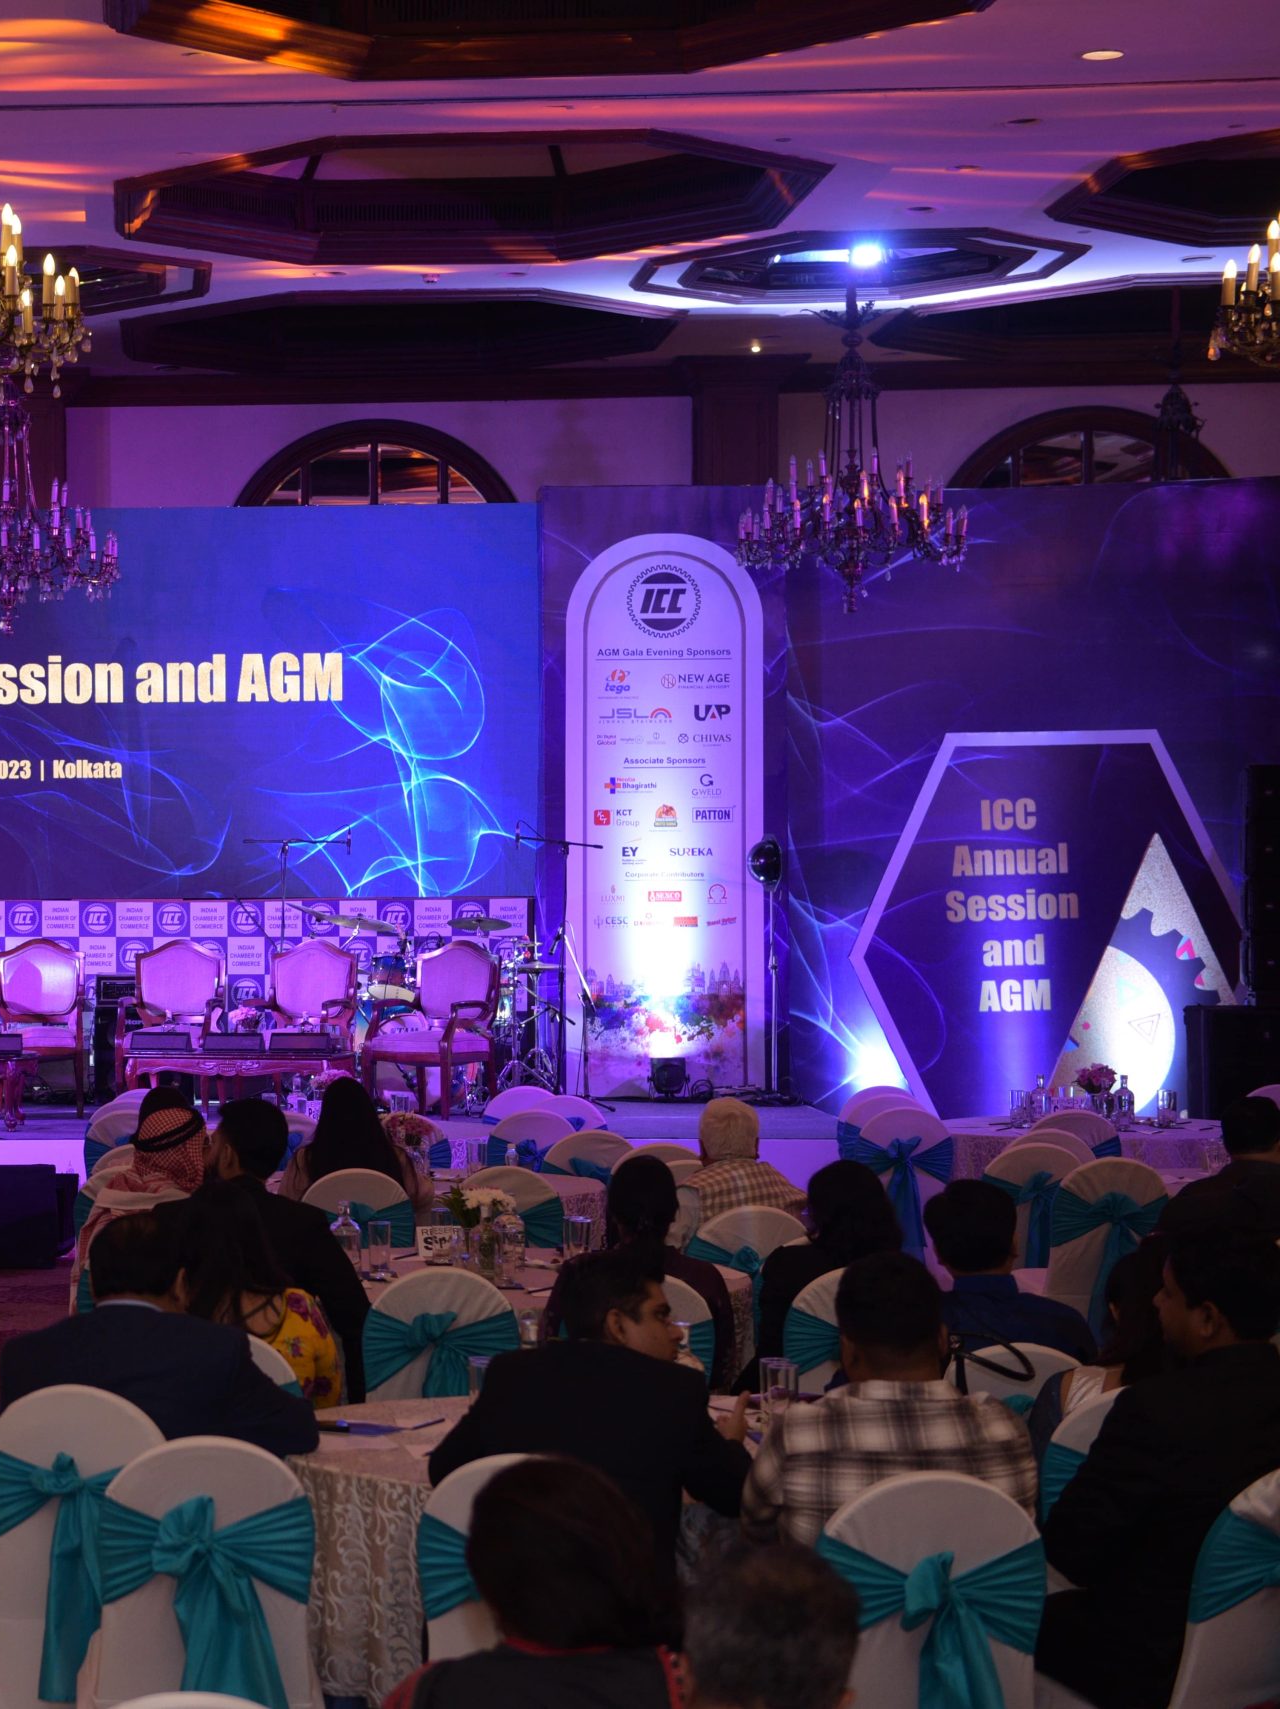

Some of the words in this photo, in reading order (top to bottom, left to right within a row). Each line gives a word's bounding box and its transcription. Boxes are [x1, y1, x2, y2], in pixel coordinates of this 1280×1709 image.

[639, 588, 686, 614] ICC
[622, 649, 643, 657] Gala
[646, 648, 684, 657] Evening
[686, 647, 731, 656] Sponsors
[135, 653, 226, 704] and
[237, 652, 343, 702] AGM
[678, 674, 704, 682] NEW
[707, 673, 730, 682] AGE
[693, 734, 732, 743] CHIVAS
[666, 757, 706, 765] Sponsors
[53, 759, 122, 778] Kolkata
[622, 782, 657, 790] Bhagirathi
[695, 809, 731, 820] PATTON
[980, 798, 1037, 831] ICC
[622, 846, 638, 857] EY
[952, 842, 1069, 877] Annual
[945, 888, 1079, 923] Session
[14, 913, 33, 924] ICC
[88, 913, 107, 924] ICC
[162, 913, 181, 924] ICC
[605, 917, 629, 925] CESC
[982, 934, 1045, 967] and
[979, 979, 1052, 1012] AGM
